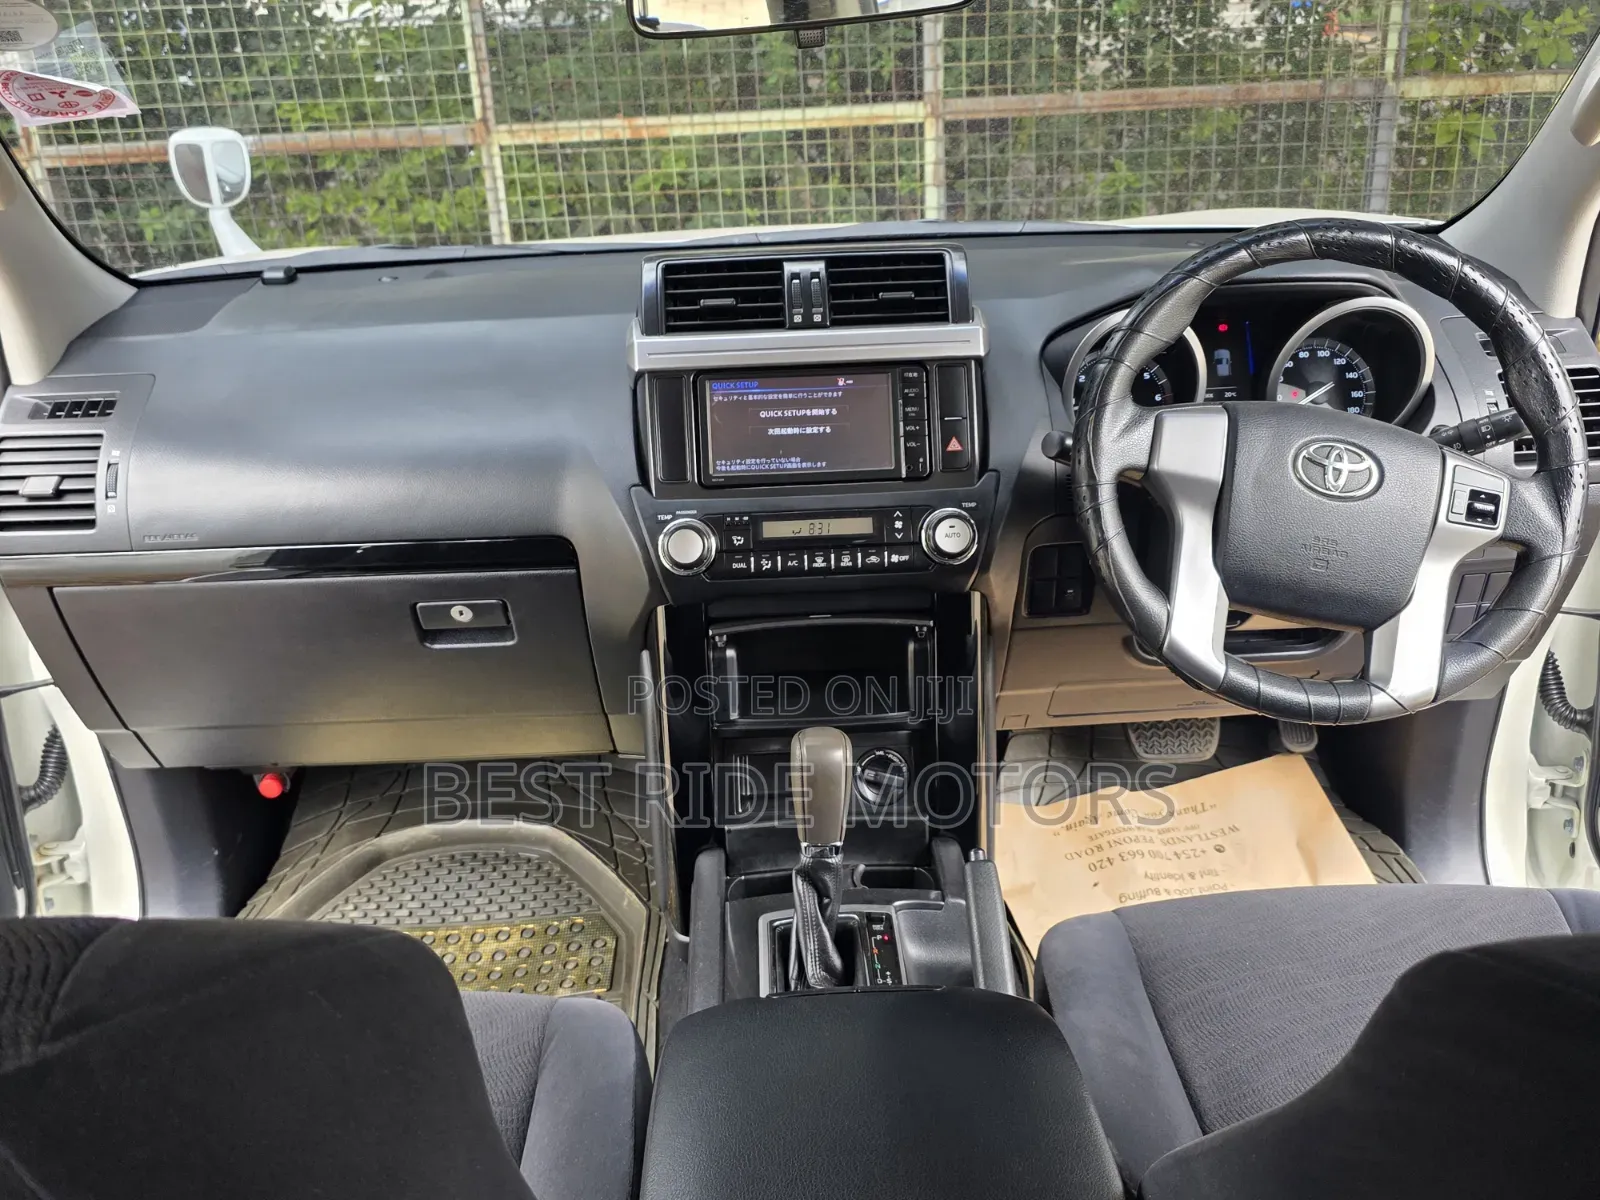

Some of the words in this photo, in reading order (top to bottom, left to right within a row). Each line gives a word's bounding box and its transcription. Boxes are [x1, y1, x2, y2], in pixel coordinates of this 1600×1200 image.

[712, 382, 735, 390] QUICK
[735, 381, 759, 389] SETUP
[1078, 375, 1086, 383] 2
[759, 410, 783, 418] QUICK
[1106, 834, 1155, 849] PEPONI
[1160, 824, 1240, 847] WESTLANDS
[1064, 844, 1104, 861] ROAD
[1118, 849, 1145, 862] 663
[1173, 848, 1207, 860] +254
[1088, 856, 1115, 873] 420
[1144, 870, 1185, 882] Identity
[1118, 887, 1161, 904] Buffing
